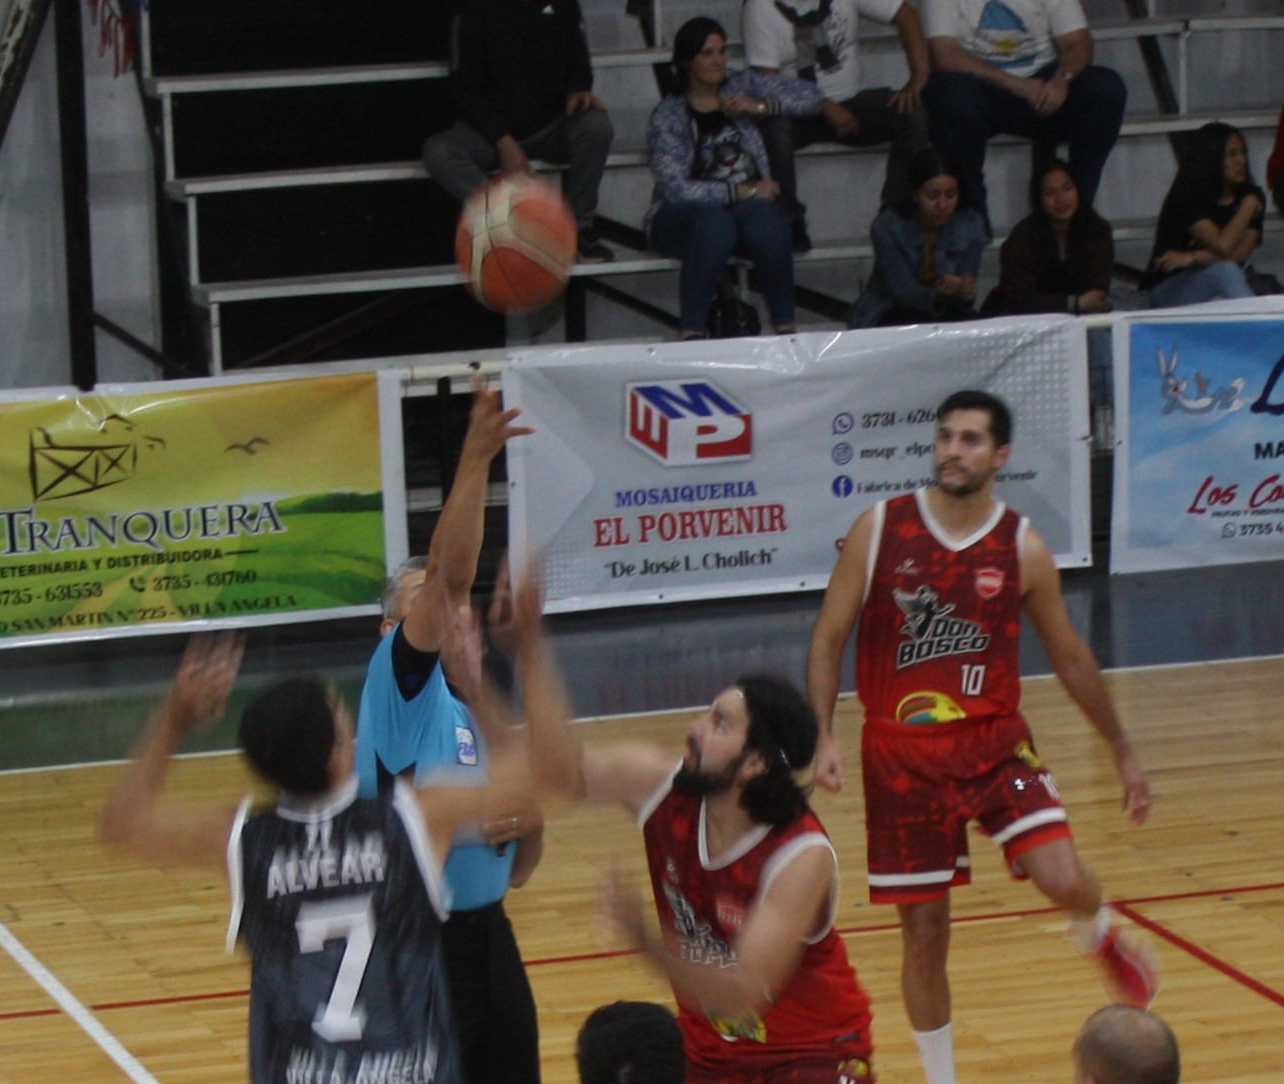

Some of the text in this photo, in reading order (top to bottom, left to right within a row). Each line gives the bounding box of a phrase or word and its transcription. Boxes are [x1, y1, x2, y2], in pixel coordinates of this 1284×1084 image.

[862, 411, 896, 430] 3731
[995, 468, 1038, 484] orvenir
[615, 480, 758, 508] MOSAIQUERIA
[1187, 475, 1240, 515] Los
[593, 503, 788, 547] EL PORVENIR
[92, 558, 102, 571] Y
[107, 547, 223, 569] DISTRIBUIDORA
[640, 556, 680, 576] José
[153, 575, 192, 592] 3735
[898, 635, 991, 668] BOSCO
[960, 664, 986, 696] 10
[267, 846, 386, 899] ALVEAR
[295, 898, 378, 1042] 7
